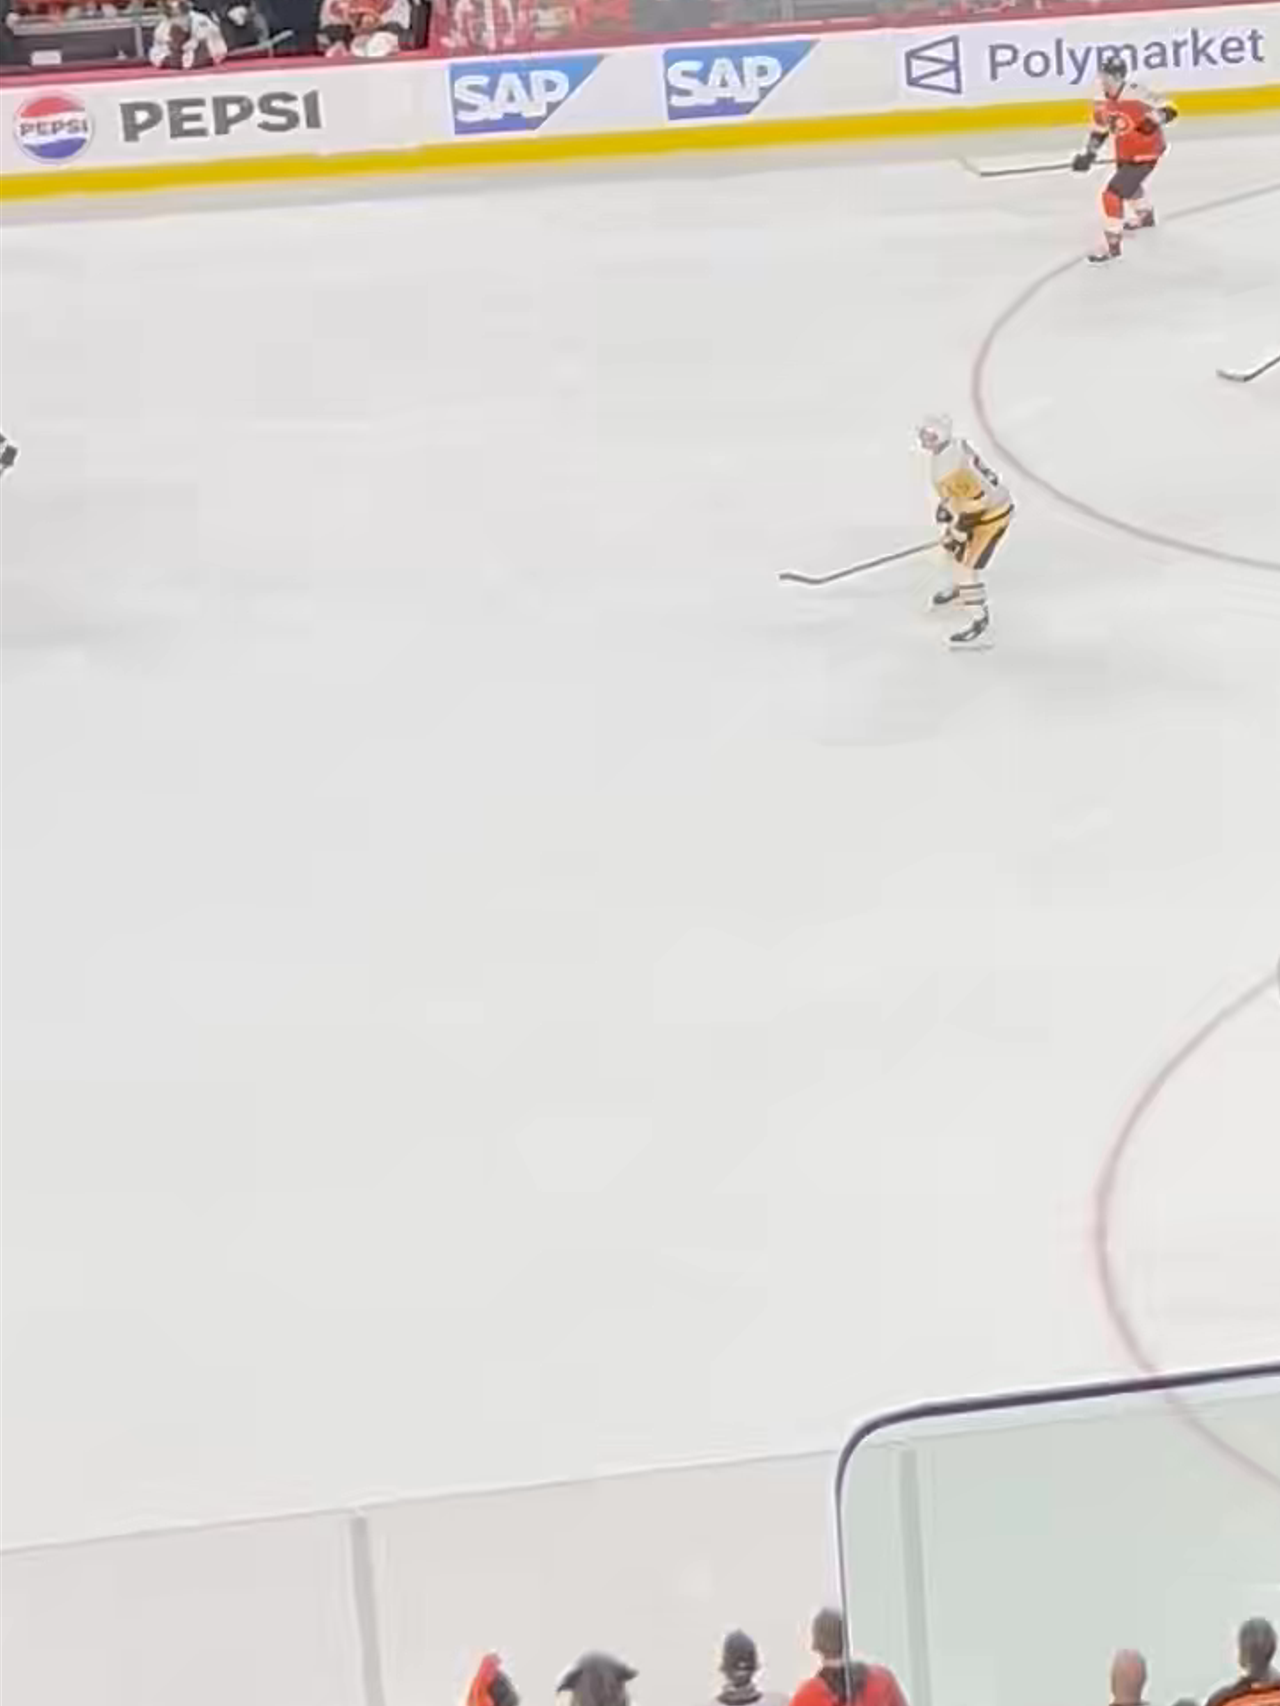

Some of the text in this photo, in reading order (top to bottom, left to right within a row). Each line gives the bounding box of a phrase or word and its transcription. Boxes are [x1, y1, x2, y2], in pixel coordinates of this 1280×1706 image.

[667, 55, 783, 110] SAP
[987, 27, 1266, 84] Polymarket
[119, 89, 324, 143] PEPSI
[453, 69, 571, 124] SAP
[18, 117, 90, 139] PEPSI
